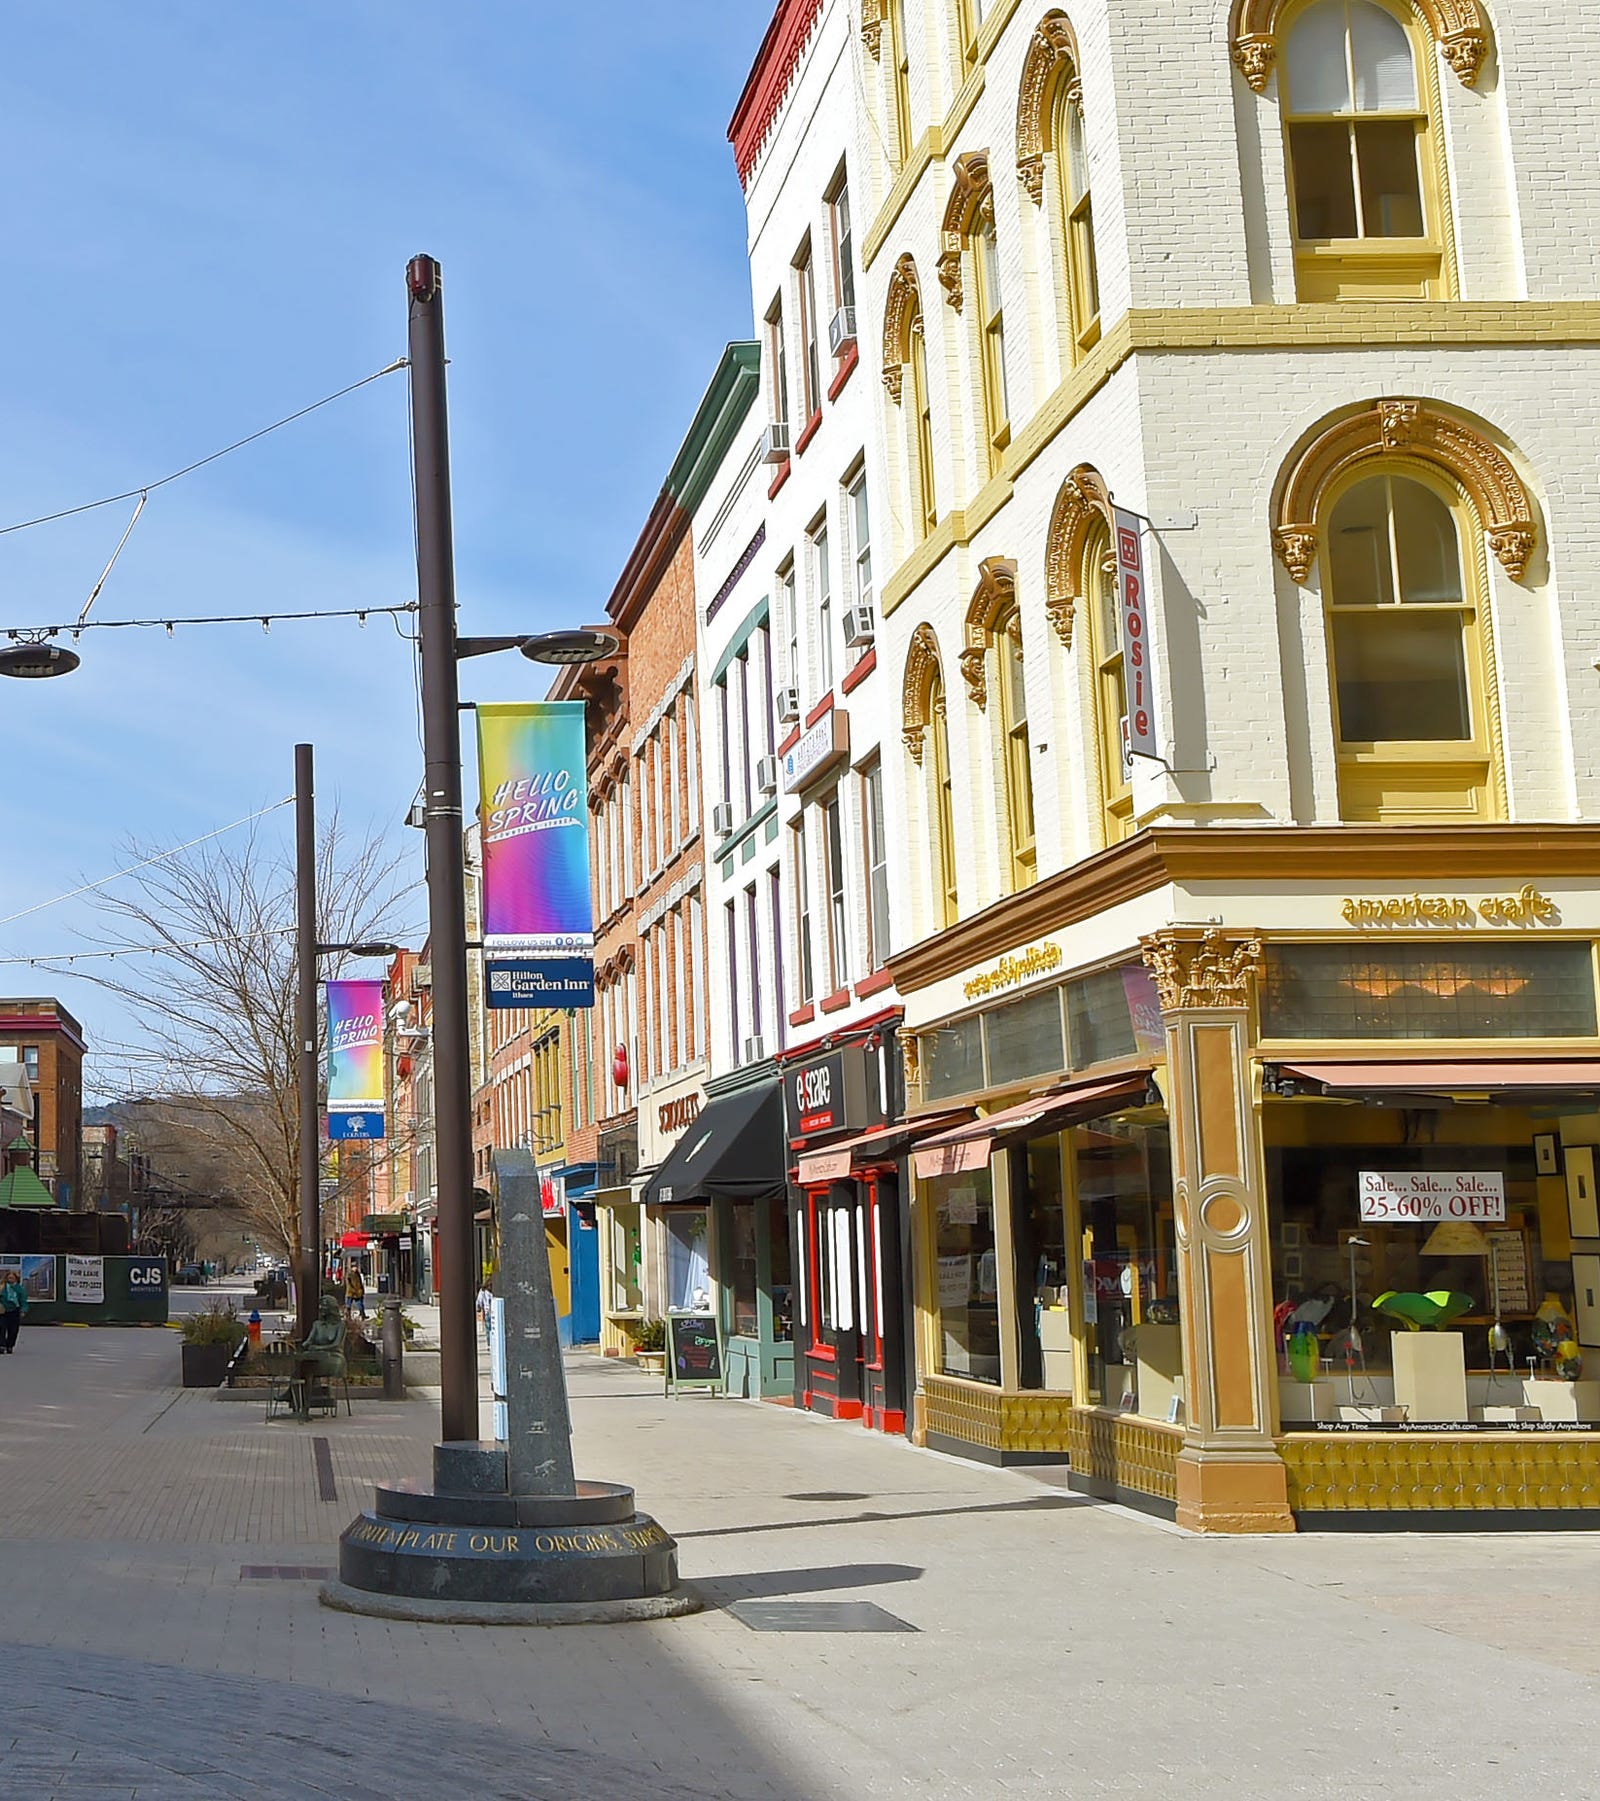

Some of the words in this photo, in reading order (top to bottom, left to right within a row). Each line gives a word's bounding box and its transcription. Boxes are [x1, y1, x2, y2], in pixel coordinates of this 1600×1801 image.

[1125, 573, 1148, 736] Rosie
[493, 769, 570, 806] HELLO
[488, 788, 579, 832] SPRING
[1340, 892, 1468, 920] american
[1477, 883, 1553, 919] crafts
[512, 971, 543, 980] Hilton
[512, 979, 562, 991] Garden
[564, 979, 589, 990] Inn
[334, 1014, 374, 1034] HELLO
[332, 1025, 378, 1048] SPRING
[1365, 1176, 1408, 1192] Sale...
[1411, 1176, 1452, 1192] Sale...
[1455, 1176, 1498, 1192] Sale...
[1364, 1195, 1442, 1217] 25-60%
[1448, 1195, 1501, 1217] OFF!
[130, 1267, 162, 1285] CJS
[1317, 1422, 1335, 1431] Shop
[1336, 1422, 1350, 1431] Any
[1351, 1422, 1368, 1430] Time
[1399, 1423, 1478, 1431] MyAmericanCrafts.com
[1521, 1422, 1535, 1431] Ship
[1536, 1422, 1557, 1431] Safely
[1557, 1422, 1592, 1431] Anywhere
[469, 1534, 519, 1552] OUR
